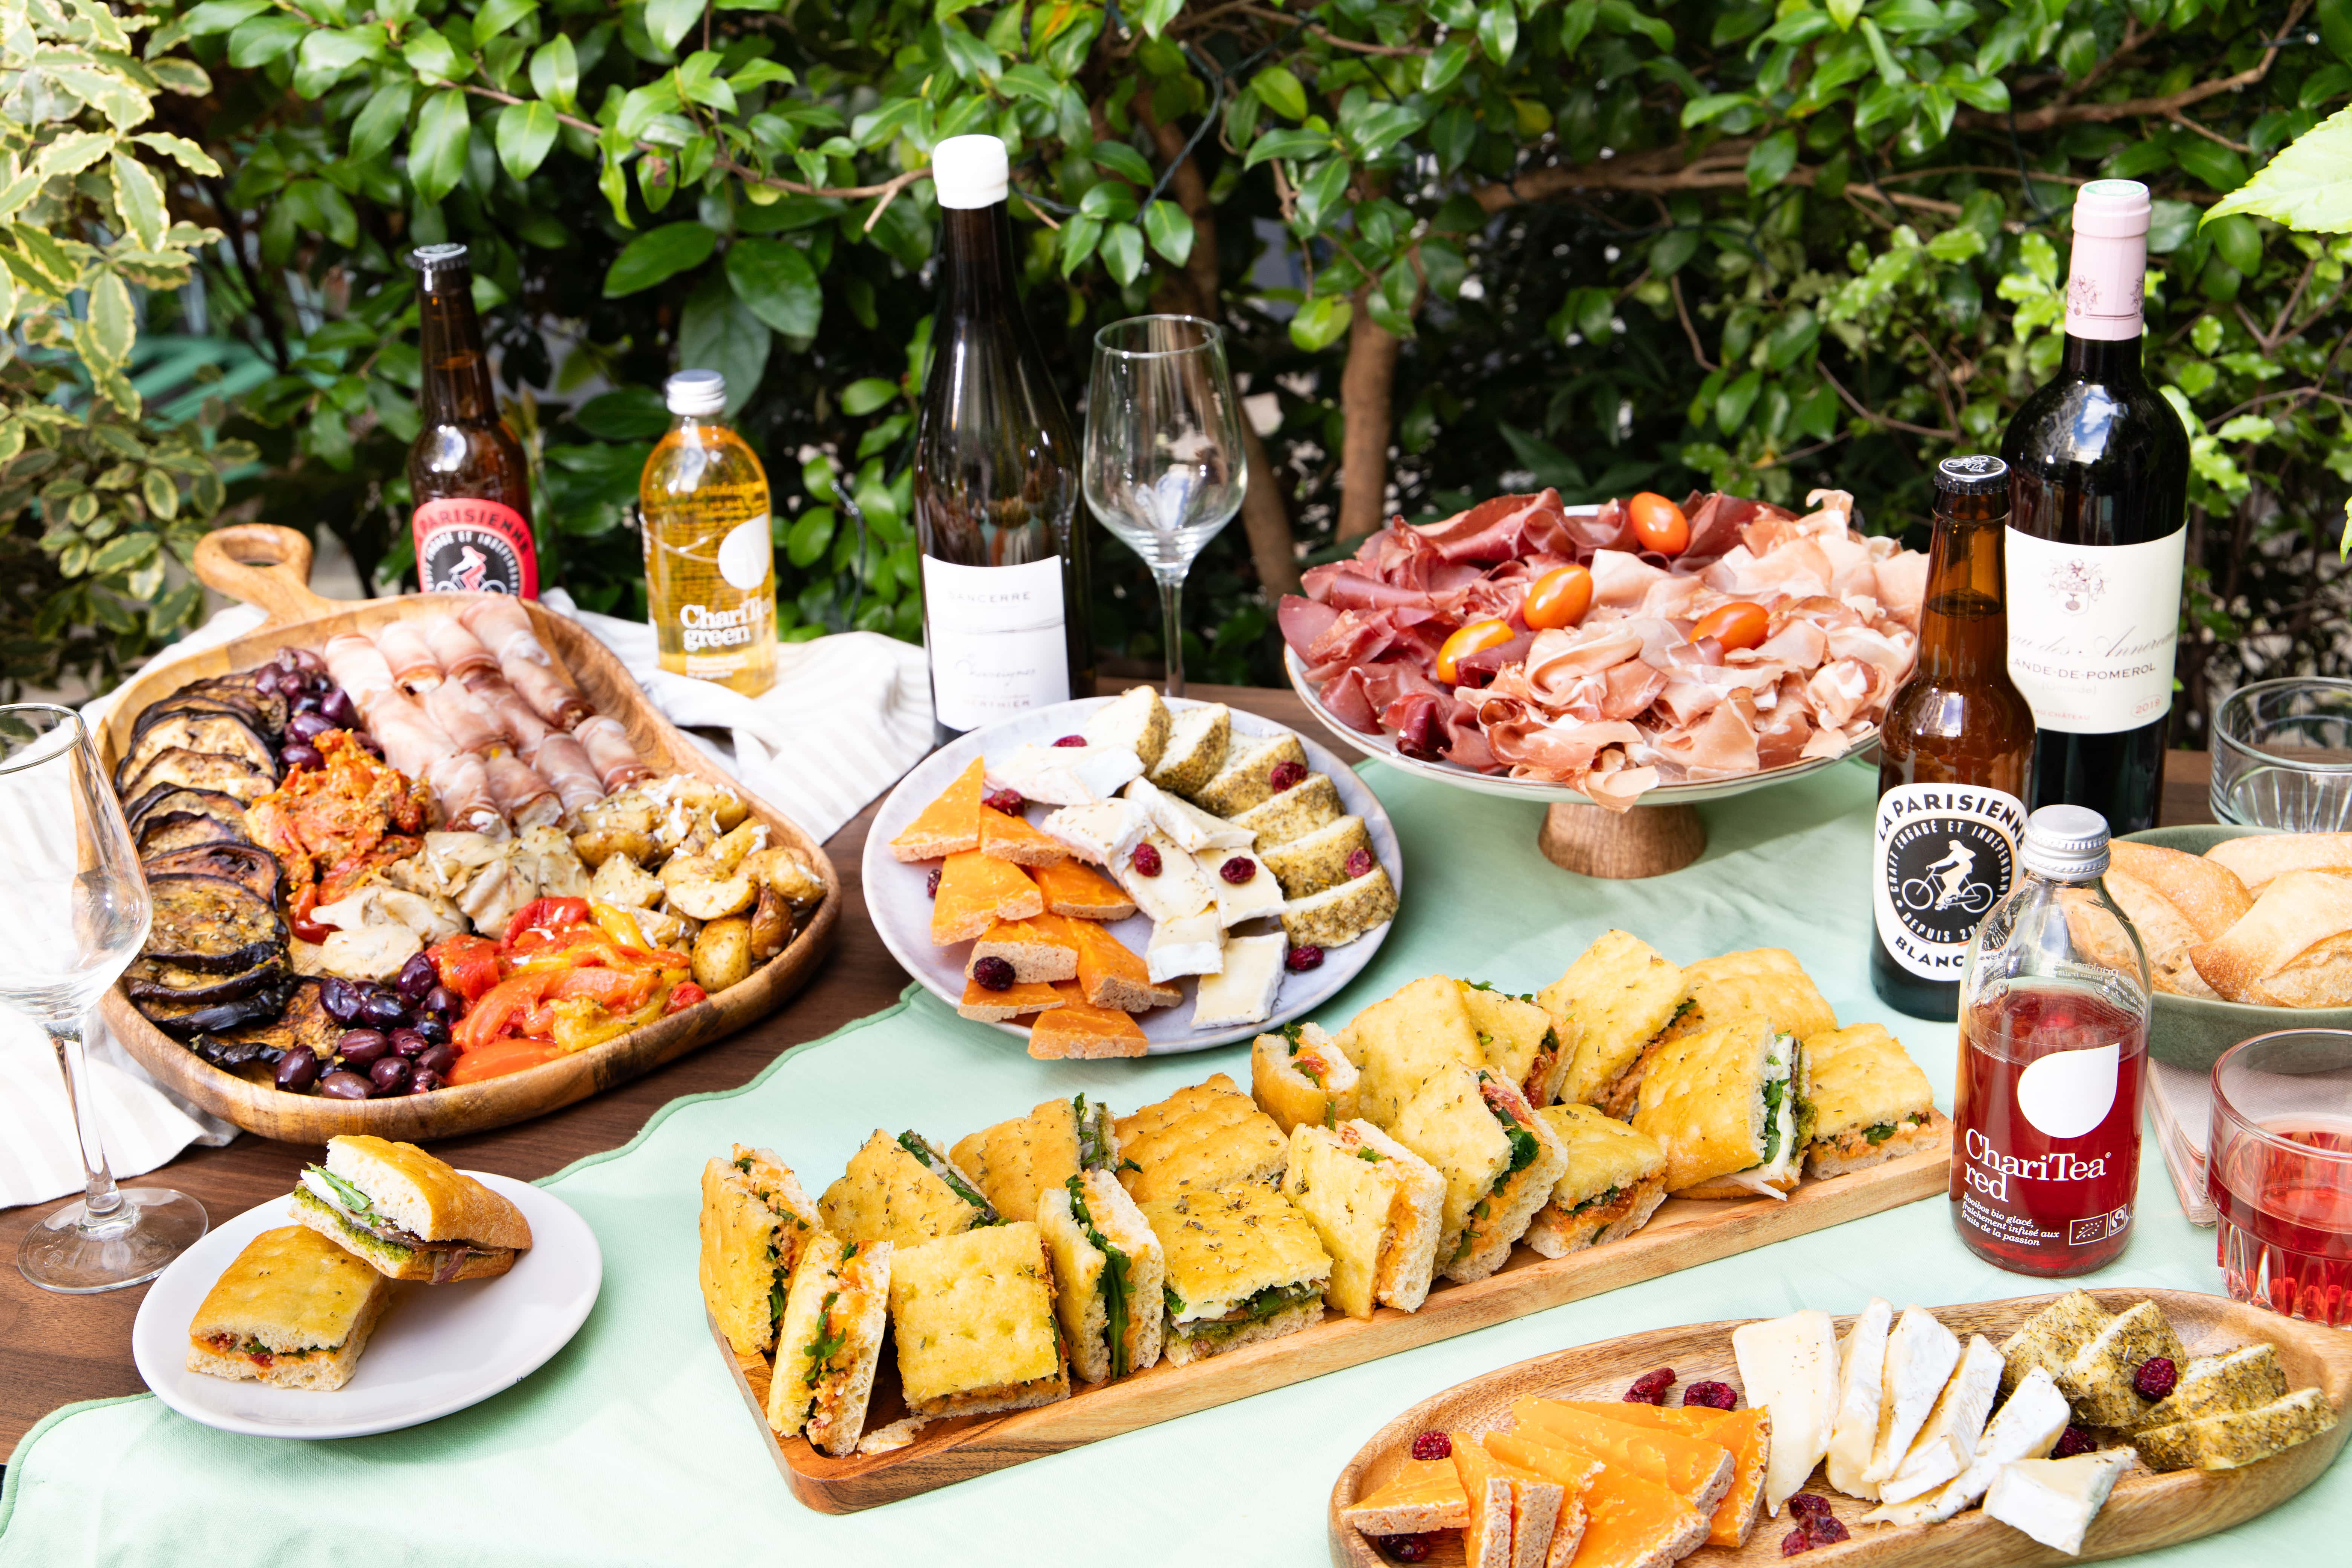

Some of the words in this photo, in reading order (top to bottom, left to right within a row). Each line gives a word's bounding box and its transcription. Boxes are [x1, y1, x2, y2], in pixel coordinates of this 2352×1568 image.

[683, 625, 750, 652] green
[1879, 814, 1893, 842] LA
[1888, 850, 1899, 893] CRAFT
[1948, 821, 1963, 833] ET
[1902, 912, 1950, 942] DEPUIS
[1896, 936, 1965, 968] BLANC
[1964, 1162, 2009, 1202] red
[1962, 1201, 2007, 1230] fraîchement
[2009, 1224, 2040, 1237] infusé
[1963, 1191, 1990, 1214] Rooibos
[1991, 1208, 2005, 1220] bio
[2006, 1216, 2034, 1228] glacé,
[1962, 1210, 1980, 1228] fruits
[1981, 1223, 1991, 1233] de
[1992, 1228, 2001, 1238] la
[2002, 1233, 2040, 1246] passion
